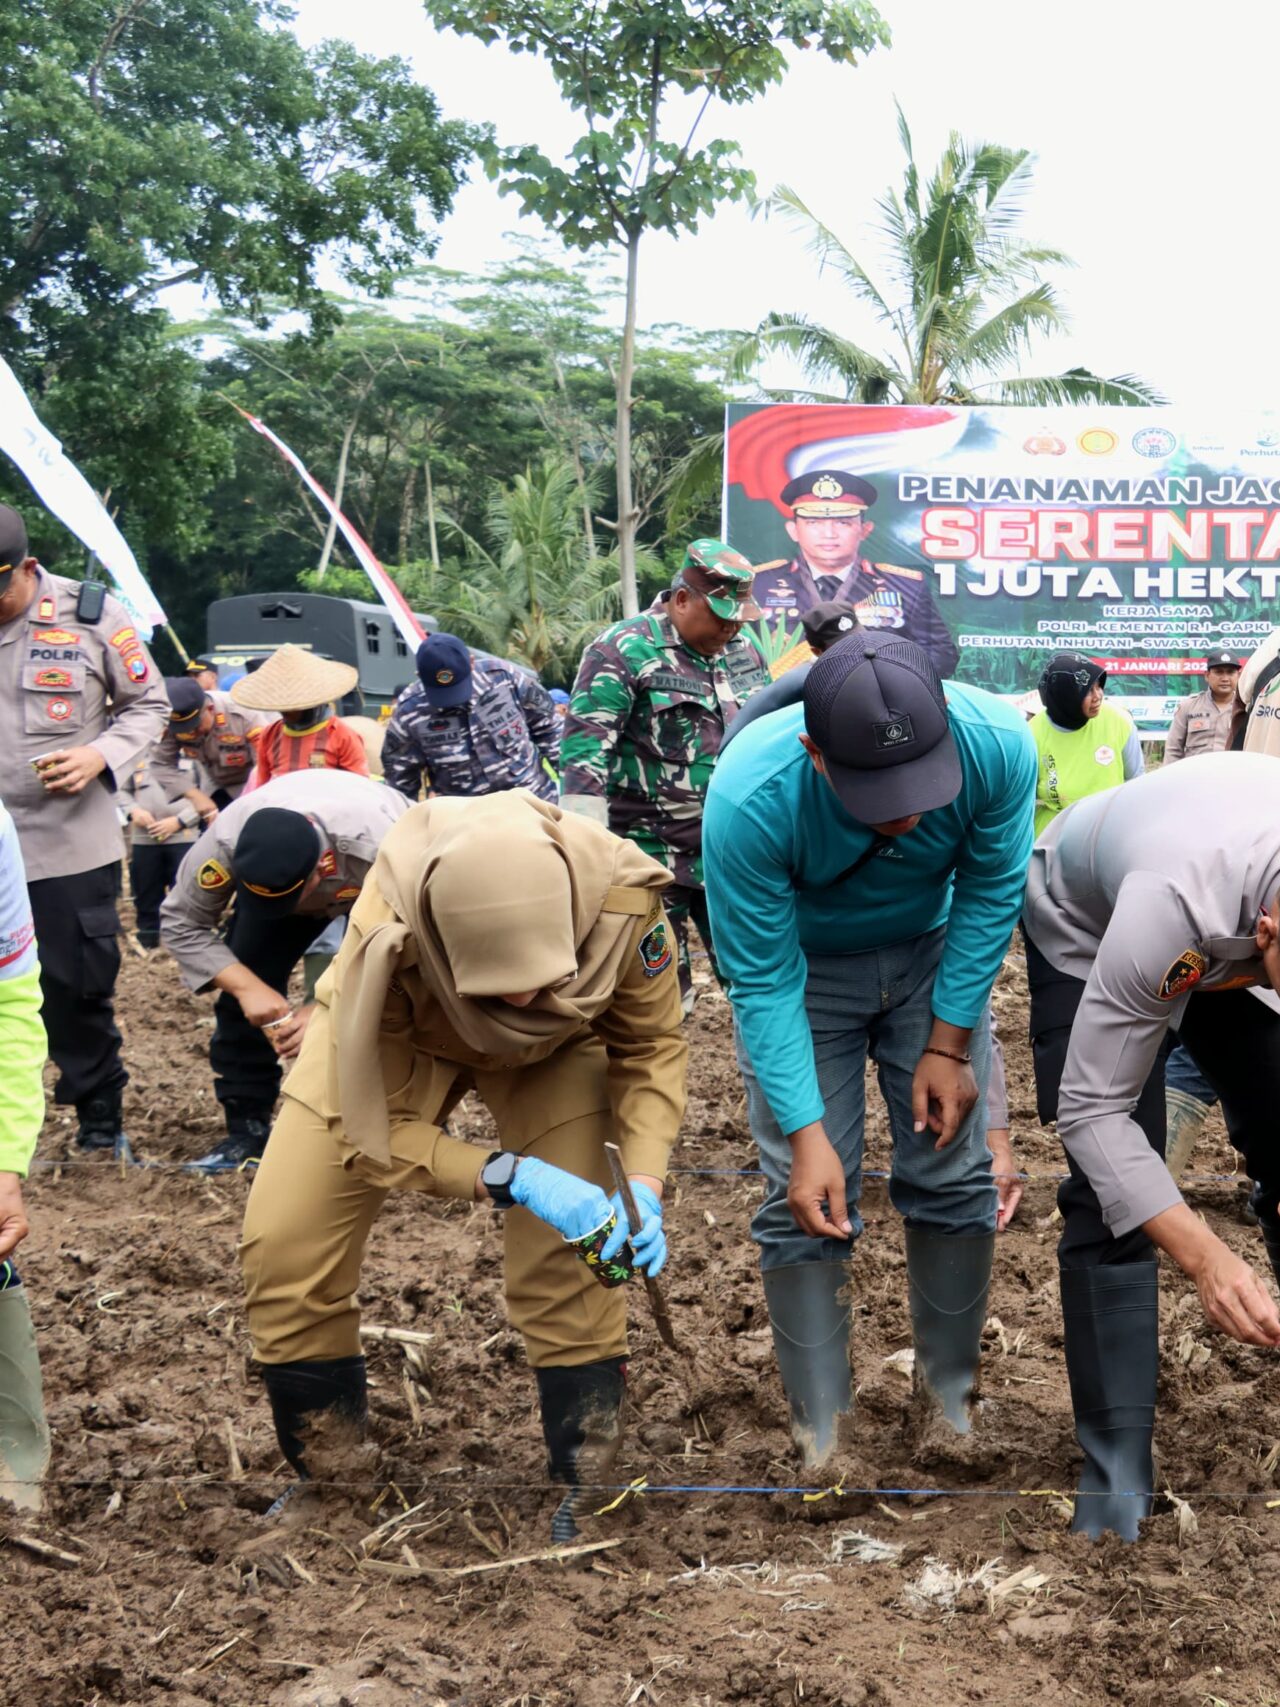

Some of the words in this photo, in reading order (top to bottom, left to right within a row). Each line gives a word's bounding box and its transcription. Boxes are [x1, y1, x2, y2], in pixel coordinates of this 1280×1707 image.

[900, 474, 1201, 503] PENANAMAN
[934, 563, 956, 595] 1
[966, 565, 1123, 598] JUTA
[1104, 605, 1158, 617] KERJA
[1160, 605, 1213, 617] SAMA
[30, 648, 79, 661] POLRI
[1104, 662, 1119, 671] 21
[1121, 662, 1180, 671] JANUARI
